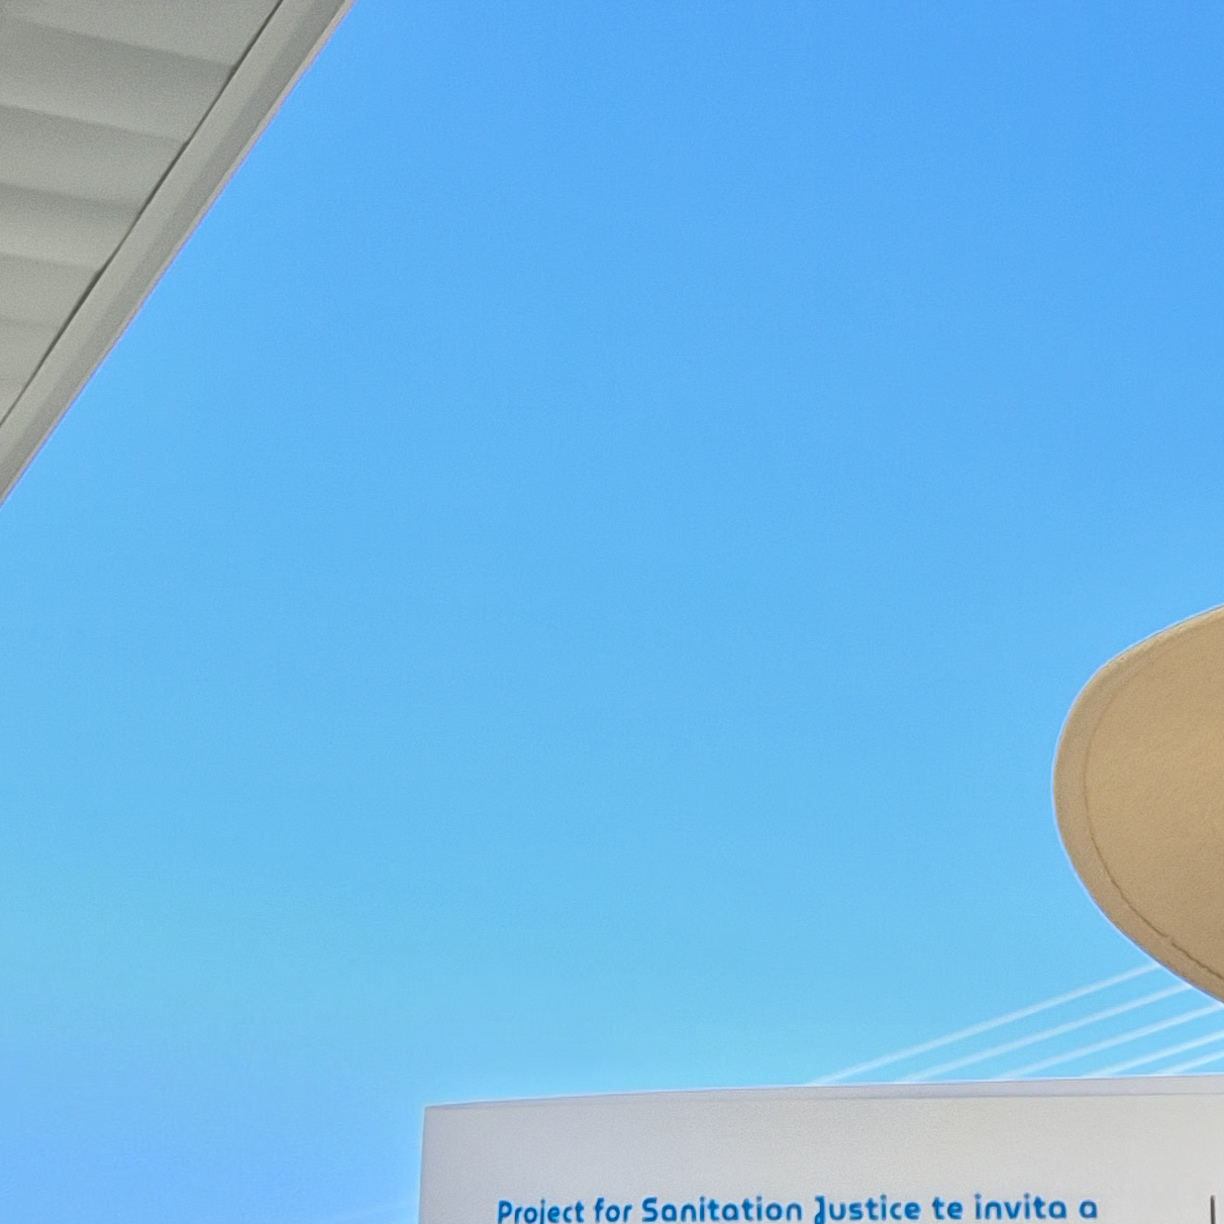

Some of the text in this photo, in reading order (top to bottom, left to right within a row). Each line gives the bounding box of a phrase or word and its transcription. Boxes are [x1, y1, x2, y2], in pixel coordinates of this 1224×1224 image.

[593, 1196, 633, 1224] for
[641, 1195, 803, 1223] Sanitation
[932, 1196, 964, 1221] te
[974, 1192, 1069, 1221] invita
[1079, 1200, 1100, 1221] a
